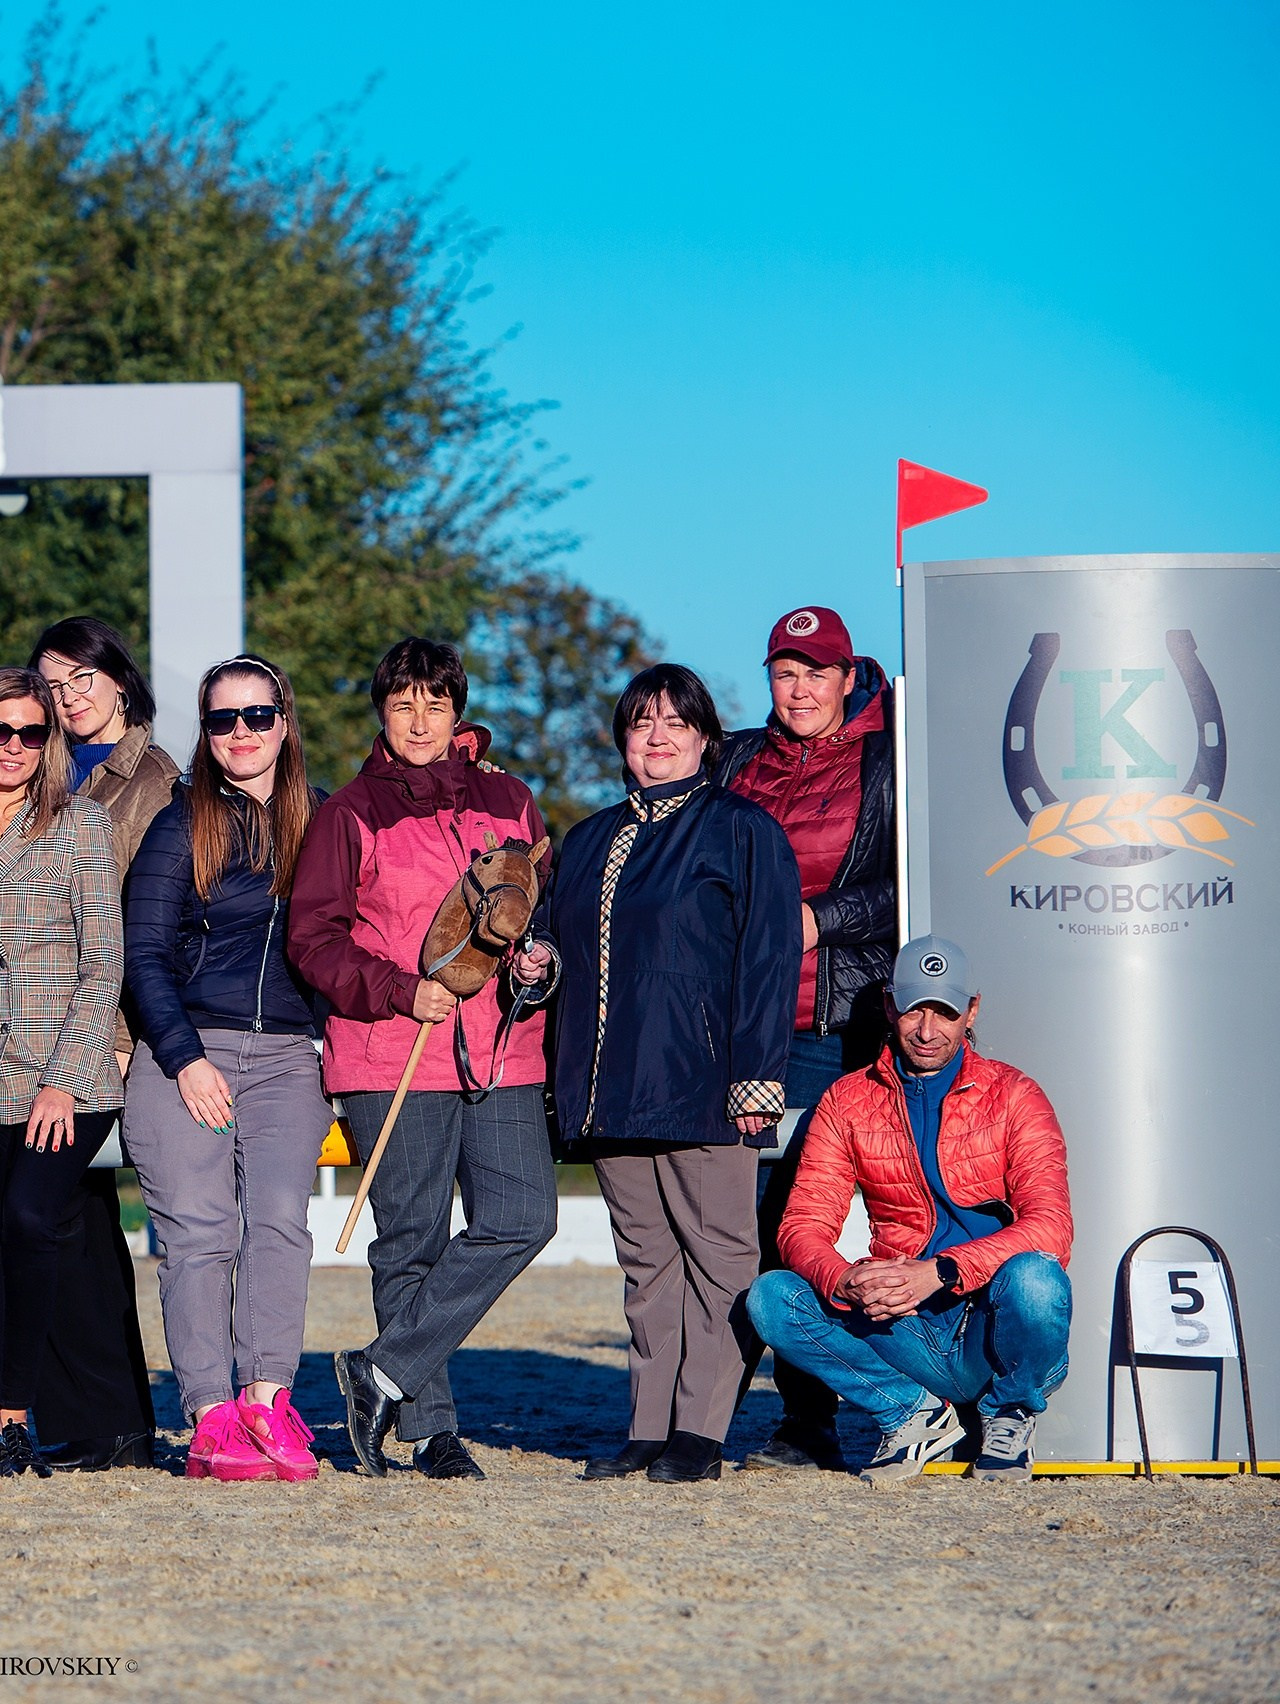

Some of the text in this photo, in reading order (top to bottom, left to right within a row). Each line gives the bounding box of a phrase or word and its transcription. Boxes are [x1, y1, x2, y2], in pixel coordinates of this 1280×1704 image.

[1059, 668, 1178, 780] К
[1010, 876, 1234, 913] КИРОВСКИЙ
[1068, 921, 1180, 936] КОННЫЙ ЗАВОД
[1167, 1270, 1205, 1315] 5
